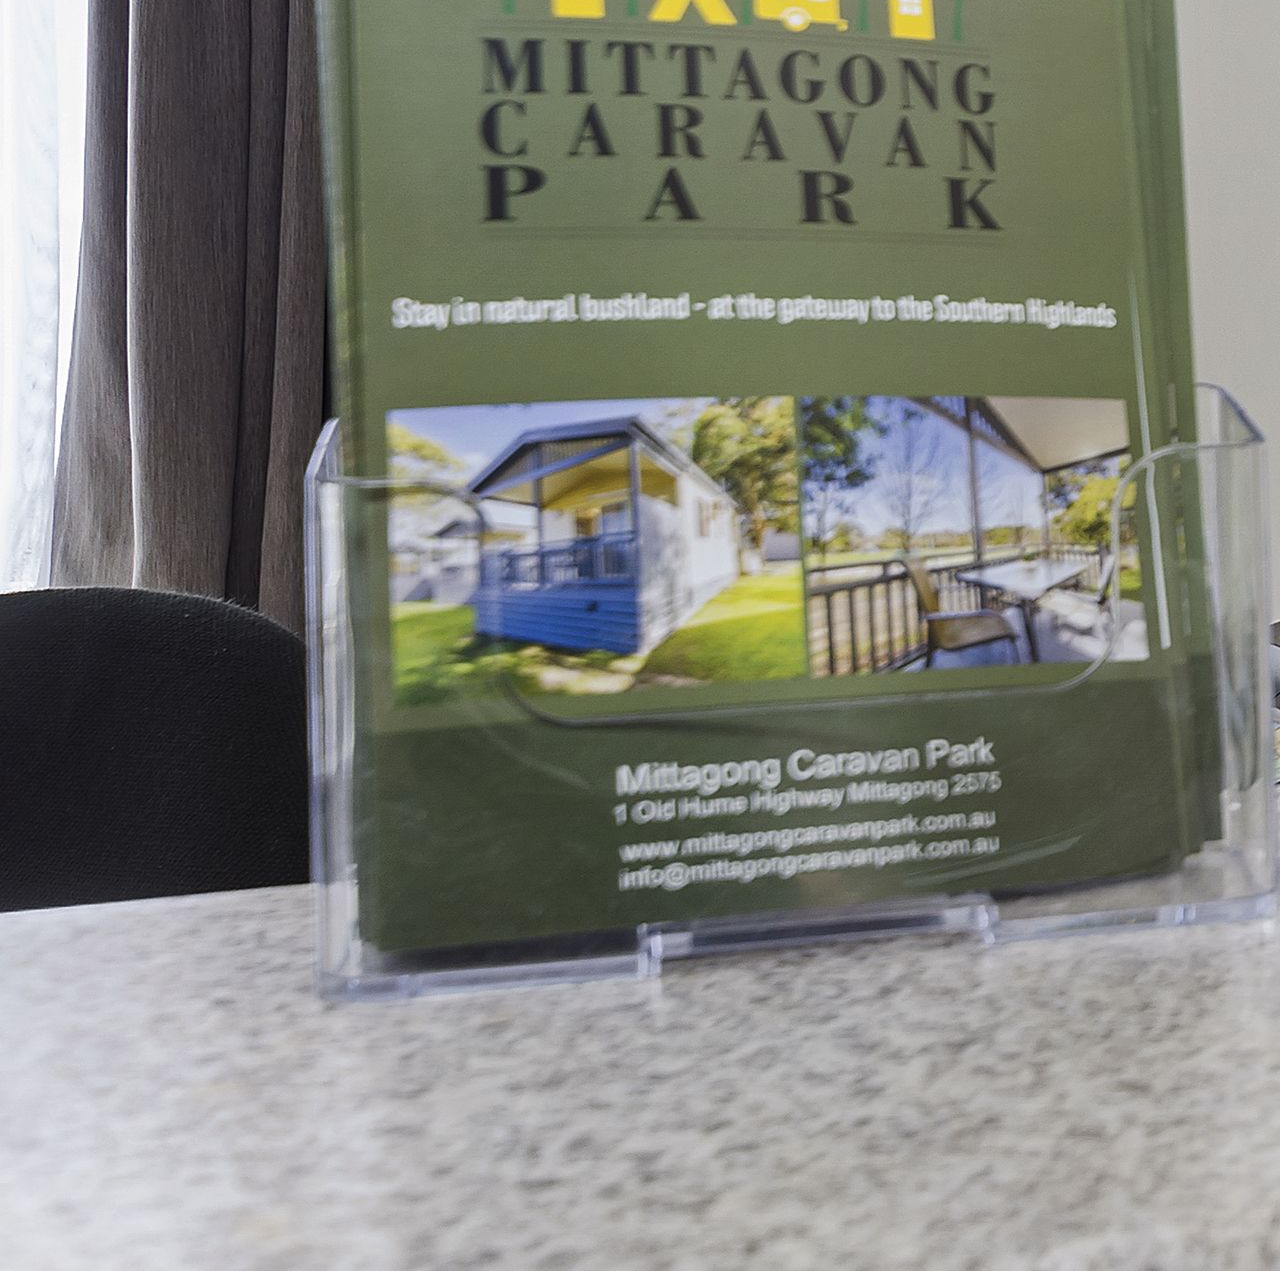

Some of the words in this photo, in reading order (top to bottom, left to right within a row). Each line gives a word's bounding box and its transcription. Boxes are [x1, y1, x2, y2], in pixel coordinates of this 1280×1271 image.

[480, 37, 996, 116] MITTAGONG
[480, 99, 998, 173] CARAVAN
[480, 163, 1005, 231] PARK
[391, 297, 449, 331] Stay
[451, 296, 480, 325] in
[482, 294, 578, 324] natural
[578, 292, 691, 321] bushland
[706, 294, 735, 320] at
[735, 293, 776, 320] the
[776, 295, 870, 325] gateway
[871, 295, 896, 321] to
[896, 294, 933, 322] the
[933, 294, 1026, 324] Southern
[1025, 298, 1117, 330] Highlands
[615, 758, 782, 797] Mittagong
[786, 748, 920, 781] Caravan
[924, 735, 996, 771] Park
[613, 802, 628, 826] 1
[630, 798, 677, 825] Old
[678, 795, 749, 820] Hume
[750, 786, 846, 816] Highway
[846, 779, 949, 805] Mittagong
[618, 810, 997, 864] www.mittagongcaravanpark.com.au
[618, 836, 1001, 892] info@mittagongcaravanpark.com.au
